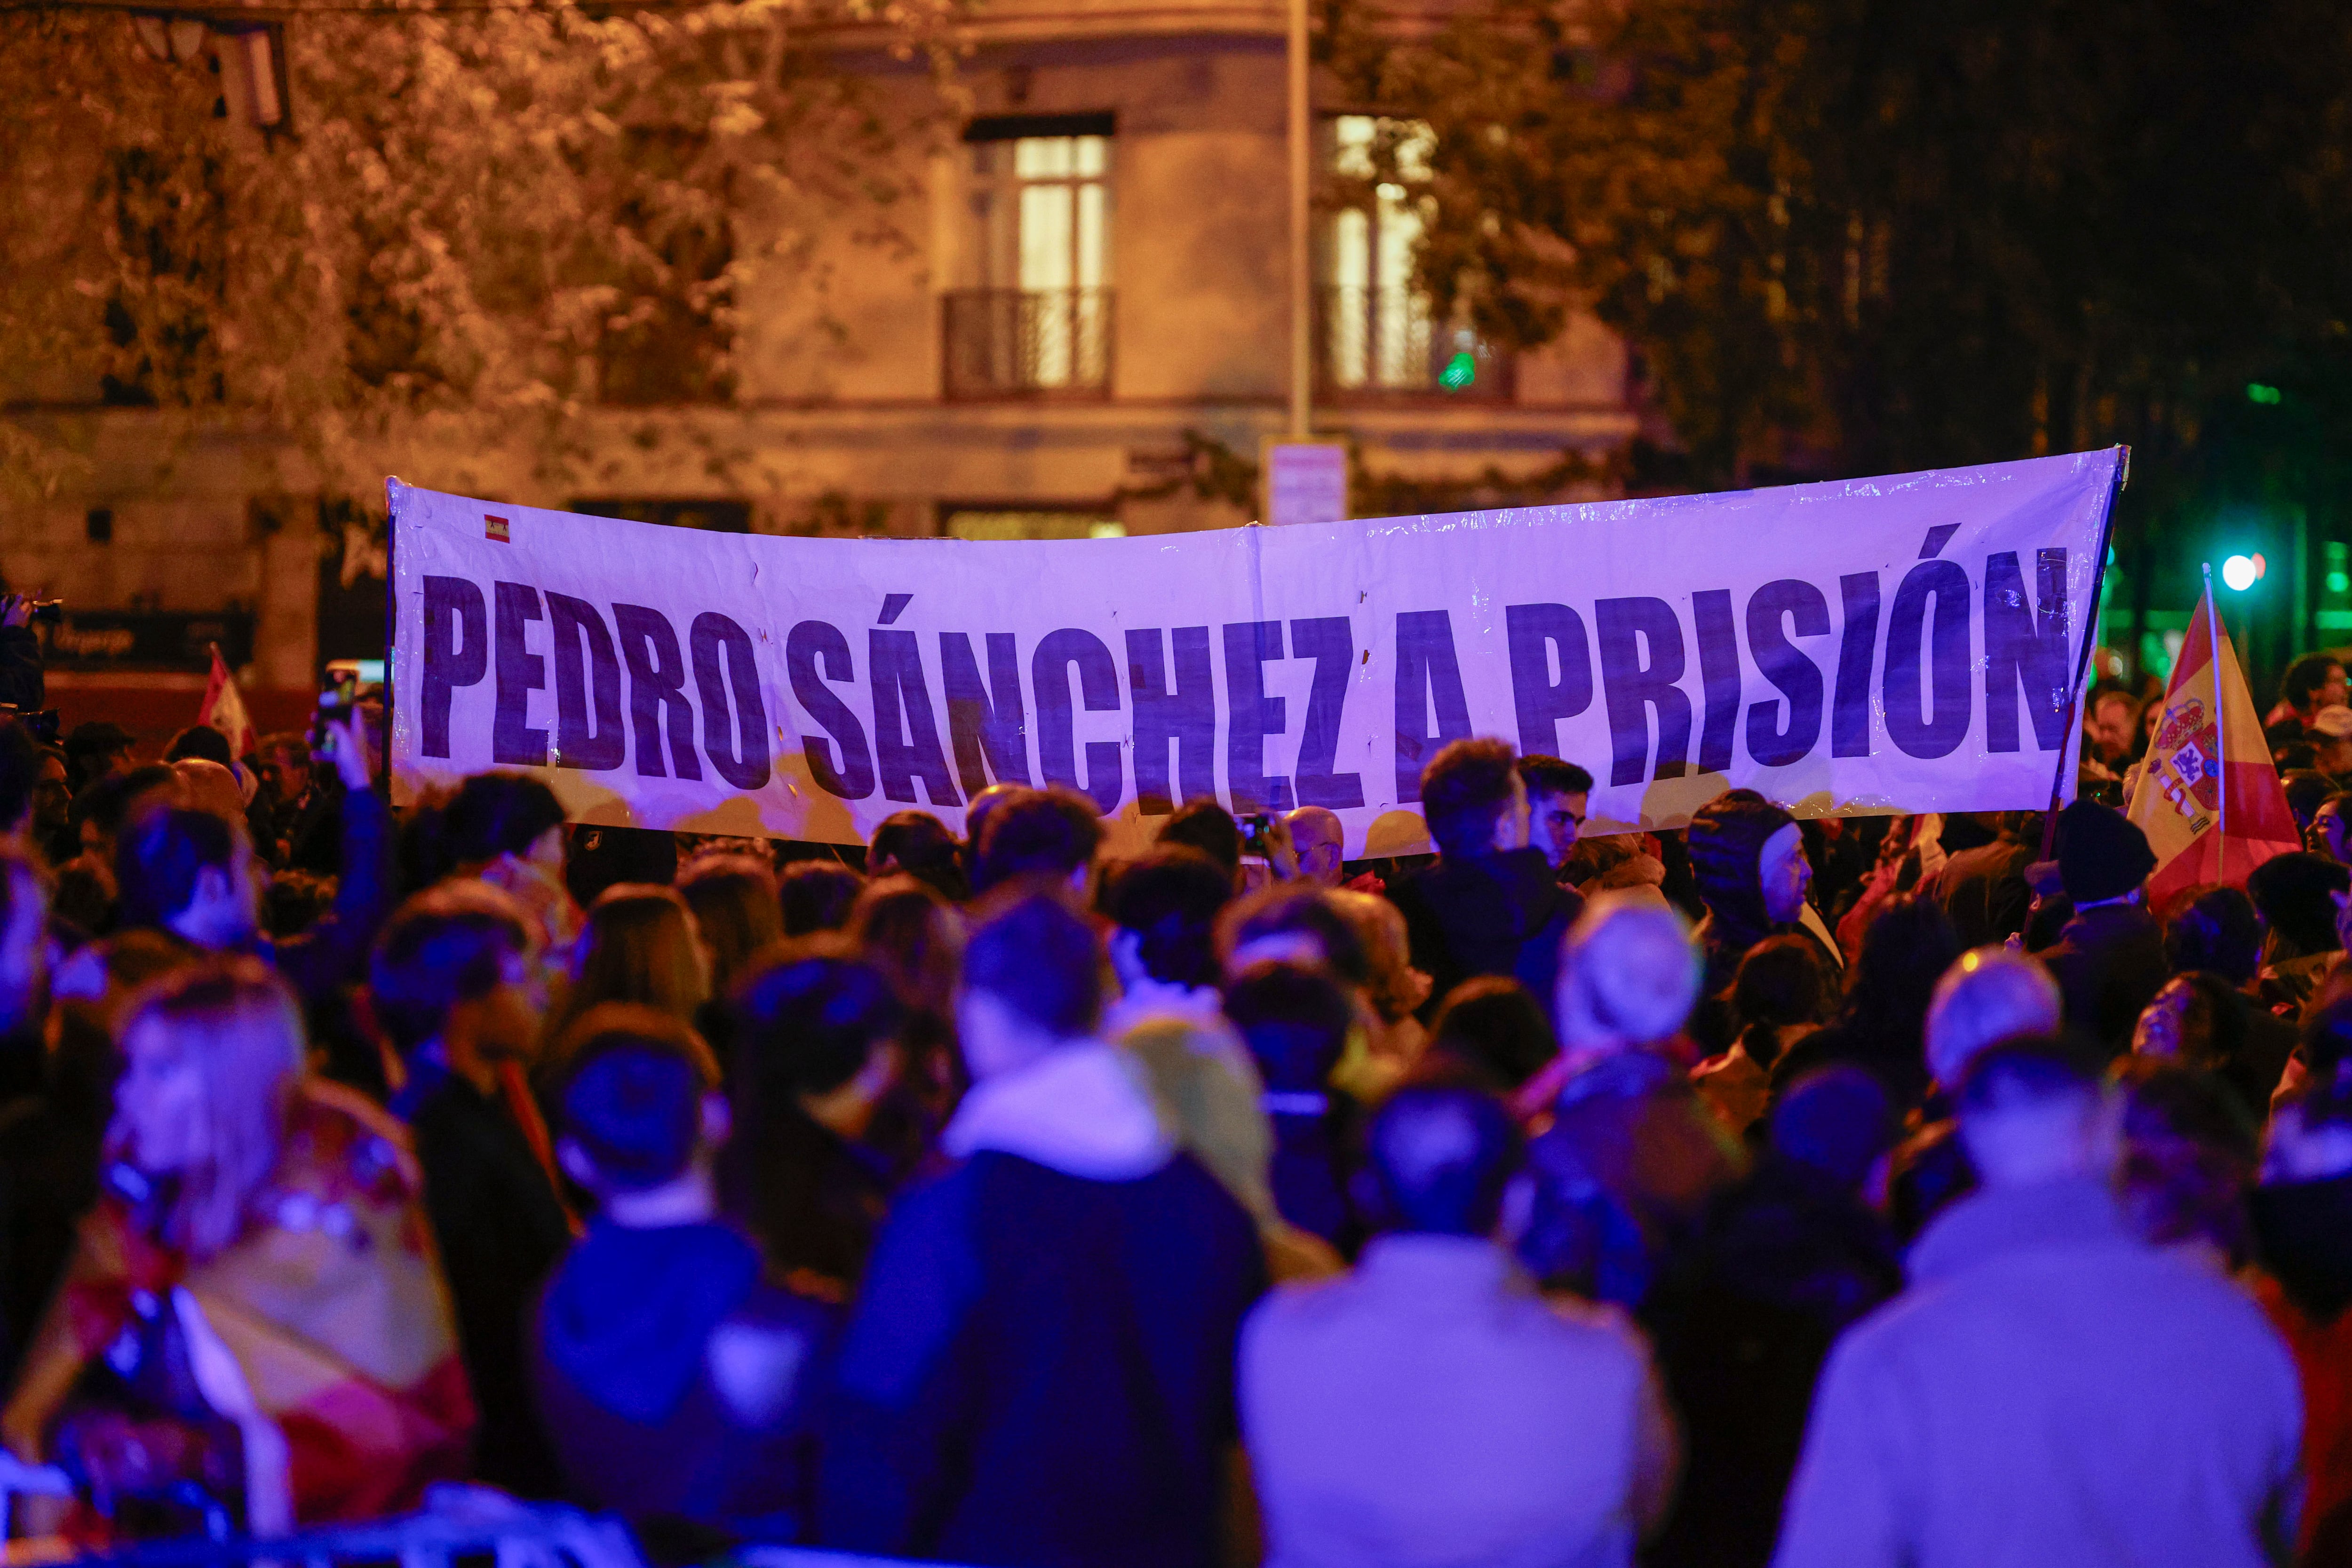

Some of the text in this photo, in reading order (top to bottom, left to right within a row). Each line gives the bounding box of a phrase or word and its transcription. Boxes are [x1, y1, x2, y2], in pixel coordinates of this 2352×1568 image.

[421, 523, 2068, 816] PEDRO SÁNCHEZ A PRISIÓN
